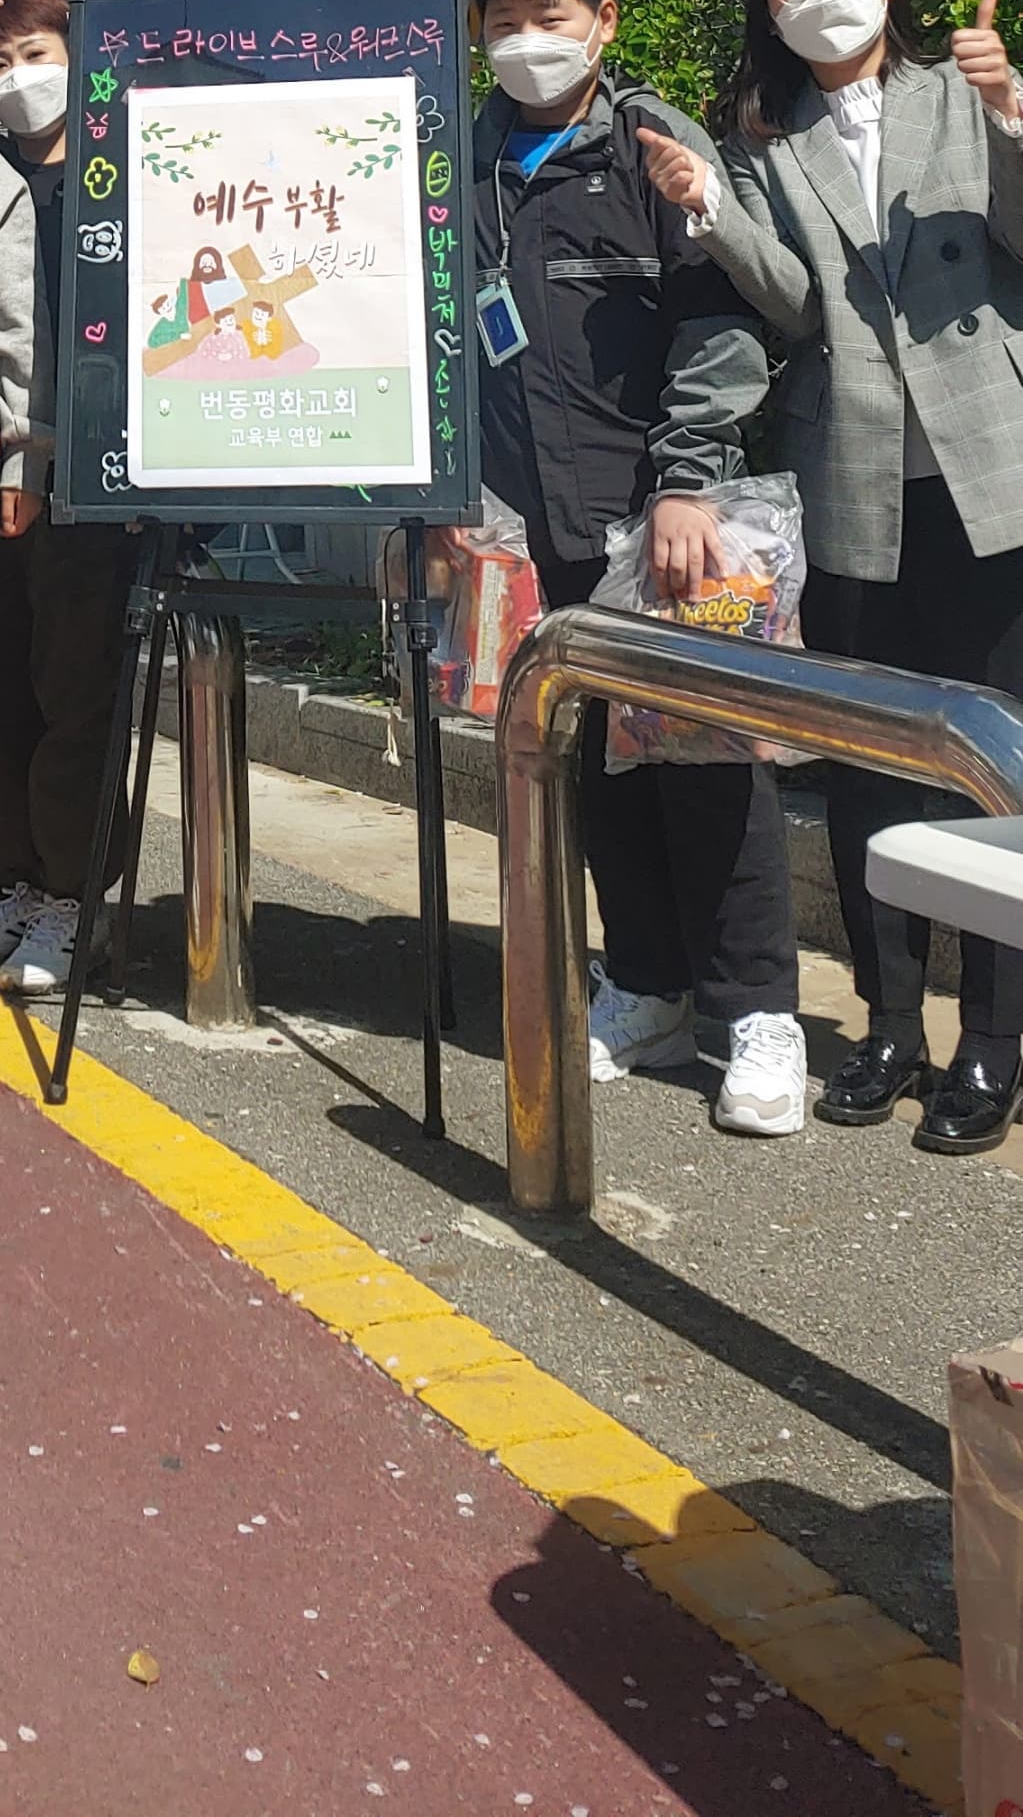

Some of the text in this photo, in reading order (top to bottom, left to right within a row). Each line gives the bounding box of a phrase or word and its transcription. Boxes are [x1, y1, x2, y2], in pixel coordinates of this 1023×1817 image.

[136, 29, 264, 64] 드라이브
[193, 179, 345, 233] 예수 부활
[268, 240, 376, 279] 하셨네
[200, 387, 357, 421] 번동평화교회
[228, 426, 323, 448] 교육부 연합
[677, 594, 750, 624] heetos
